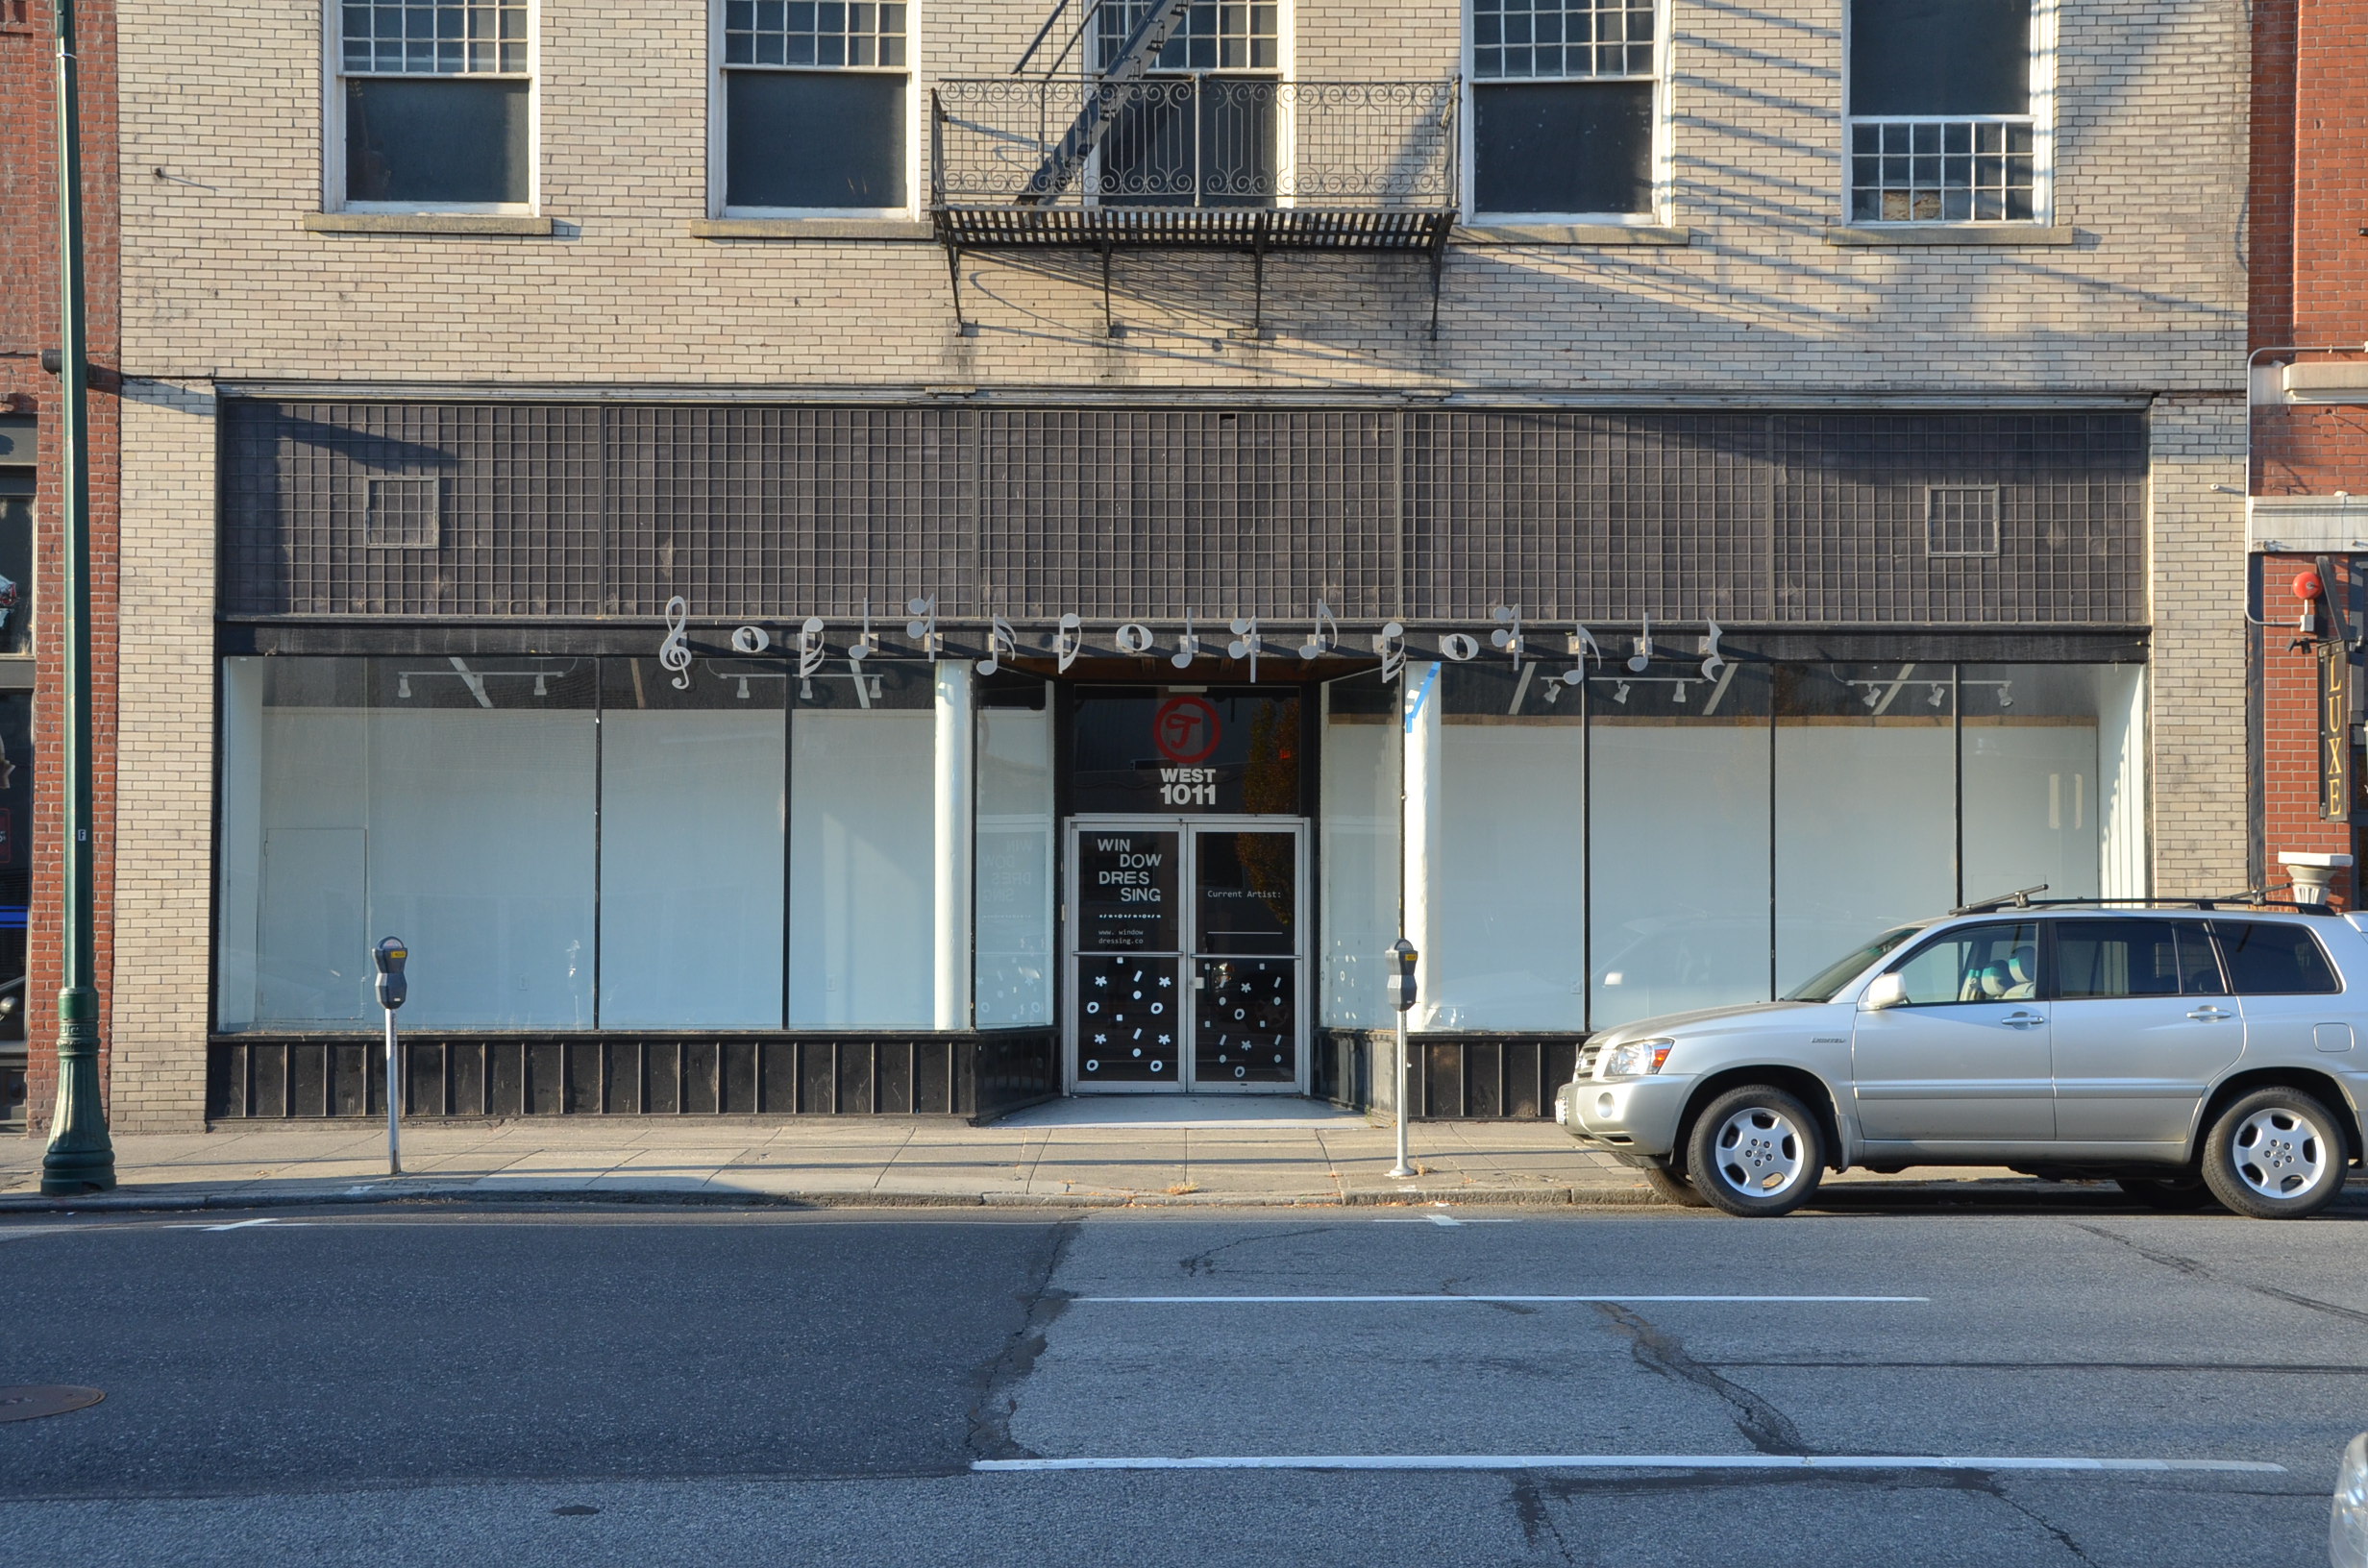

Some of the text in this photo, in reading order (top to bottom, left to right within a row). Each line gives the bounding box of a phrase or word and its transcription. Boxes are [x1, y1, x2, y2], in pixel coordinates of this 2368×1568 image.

[2328, 654, 2342, 816] LUXE
[1160, 768, 1216, 783] WEST
[1159, 783, 1216, 805] 1011
[1098, 838, 1130, 852] WIN
[1120, 853, 1162, 869] DOW
[1098, 870, 1150, 885] DRES
[1121, 887, 1161, 902] SING
[1207, 890, 1281, 898] Current Artist:
